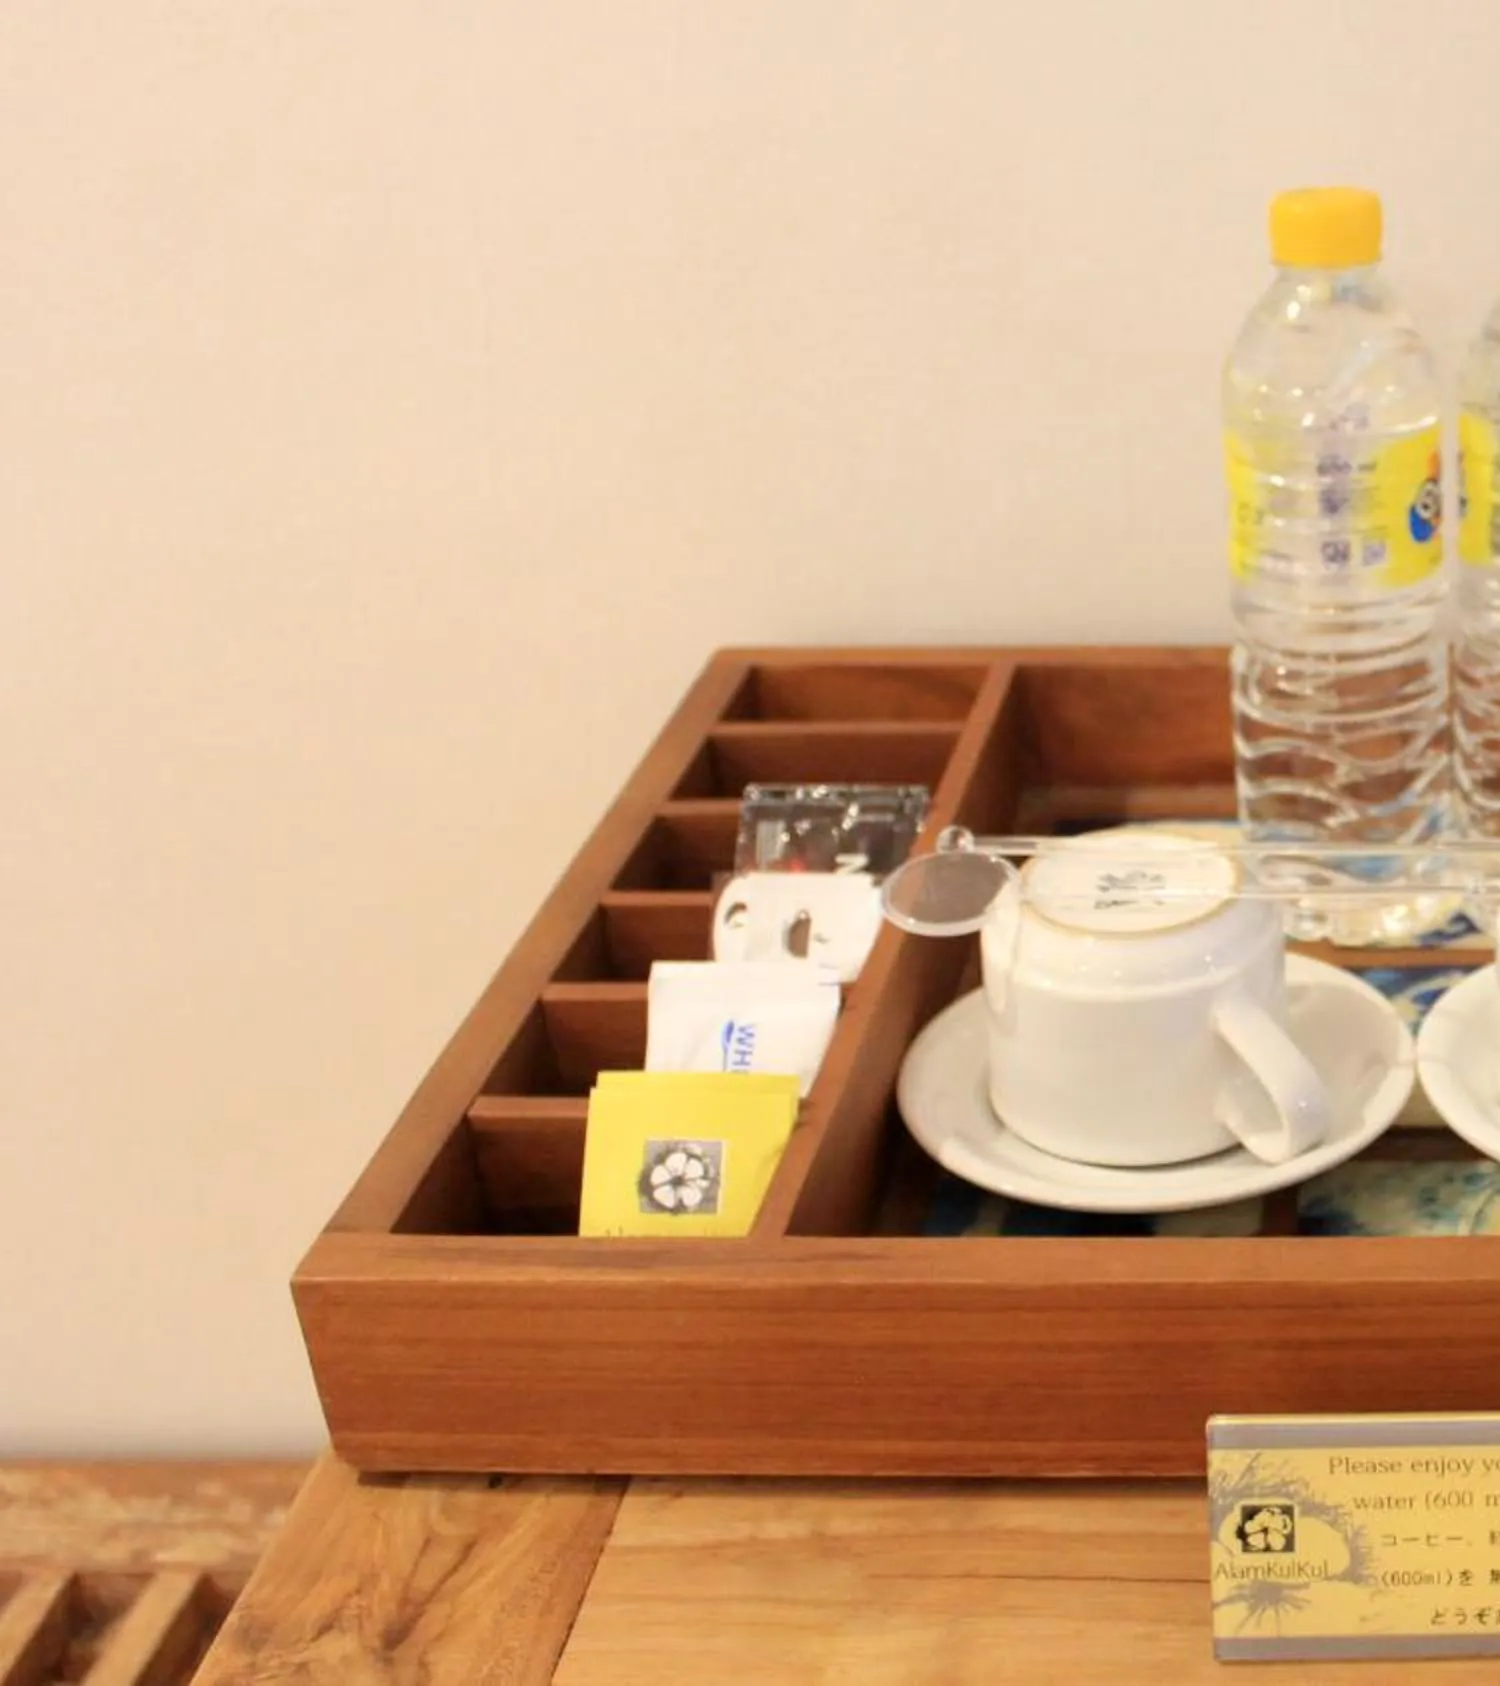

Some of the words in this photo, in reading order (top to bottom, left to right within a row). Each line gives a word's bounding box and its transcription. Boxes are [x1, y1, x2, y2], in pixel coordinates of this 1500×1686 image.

[1328, 1456, 1402, 1475] Please
[1410, 1457, 1475, 1478] enjoy
[1352, 1495, 1416, 1510] water
[1424, 1489, 1474, 1510] (600
